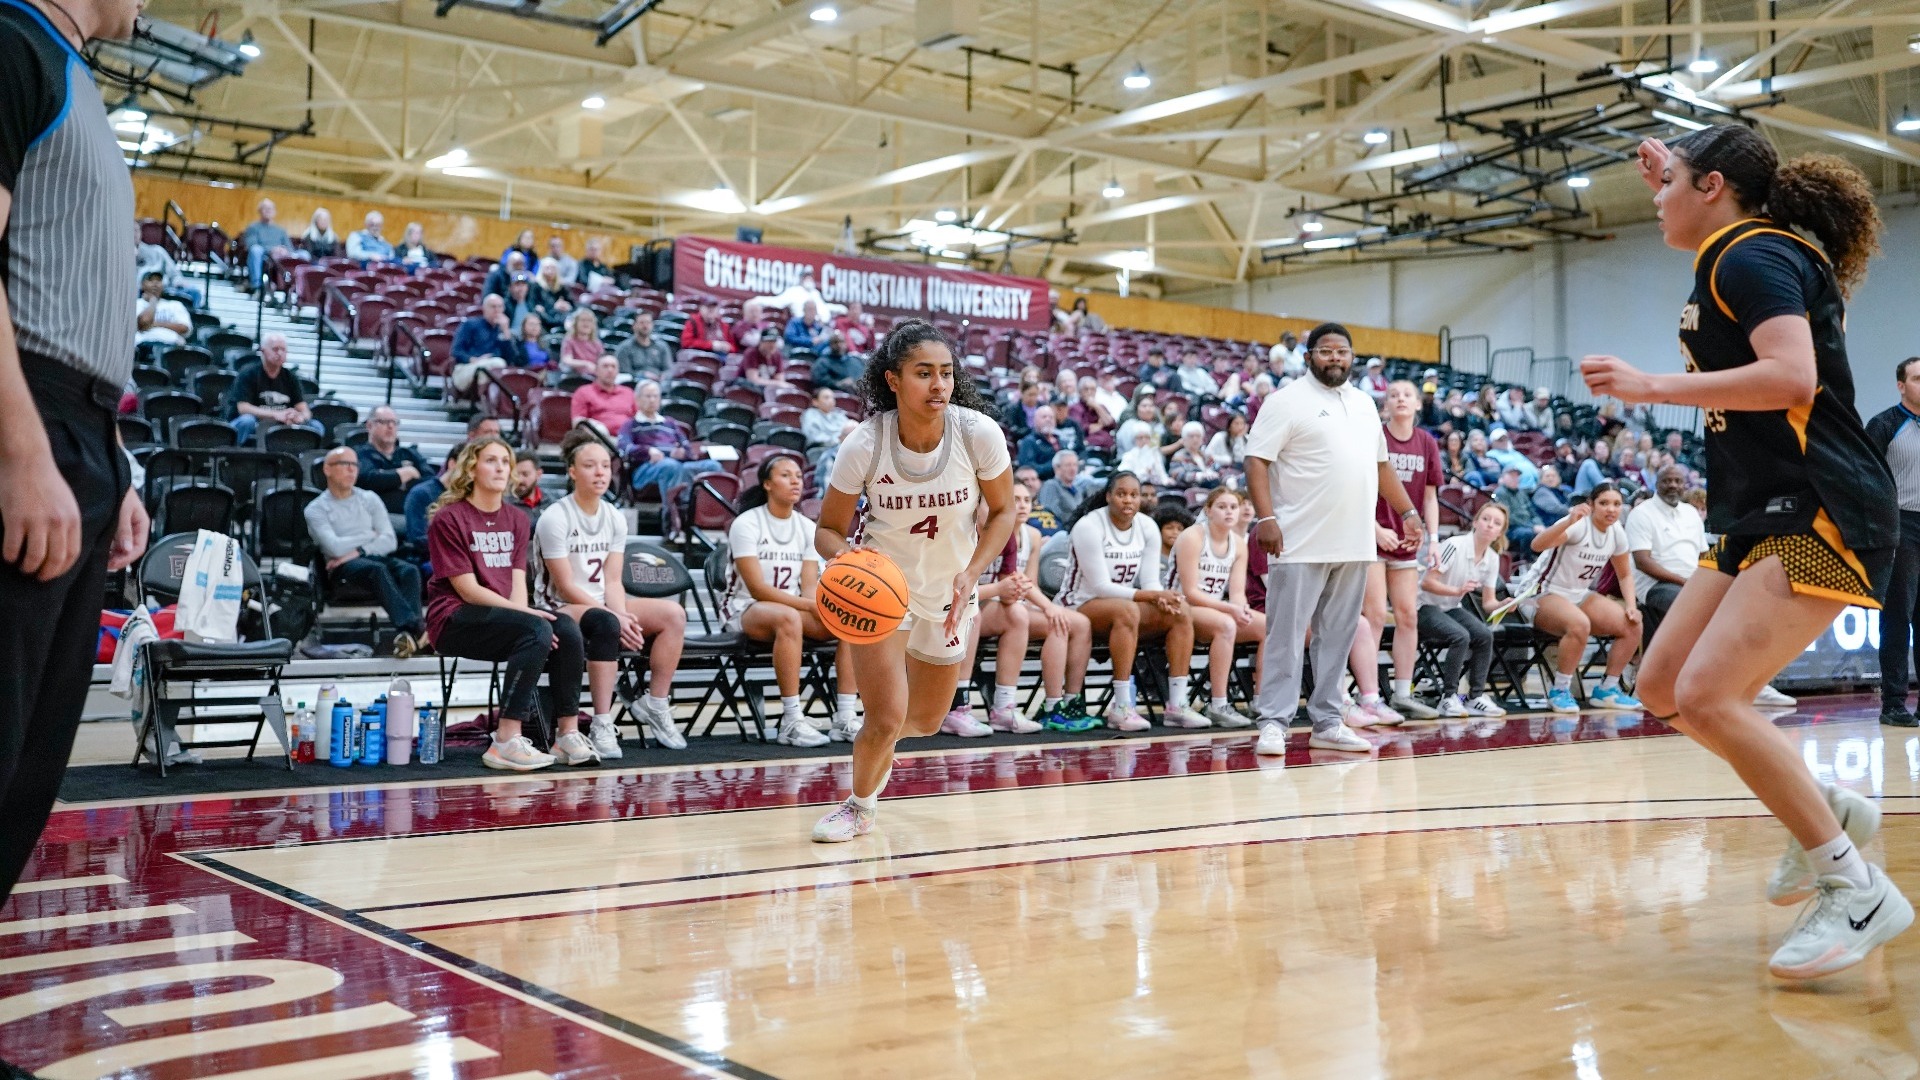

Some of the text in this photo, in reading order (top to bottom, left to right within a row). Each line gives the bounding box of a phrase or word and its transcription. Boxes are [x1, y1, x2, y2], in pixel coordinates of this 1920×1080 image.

[704, 247, 1032, 321] OKLAHOM CHRISTIAN UNIVERSITY
[879, 487, 969, 510] LADY EAGLES
[910, 515, 939, 540] 4
[587, 558, 603, 583] 2
[773, 566, 792, 589] 12
[1111, 563, 1138, 584] 35
[839, 574, 878, 599] EVO
[1202, 576, 1226, 594] 33
[821, 592, 877, 633] Wilson
